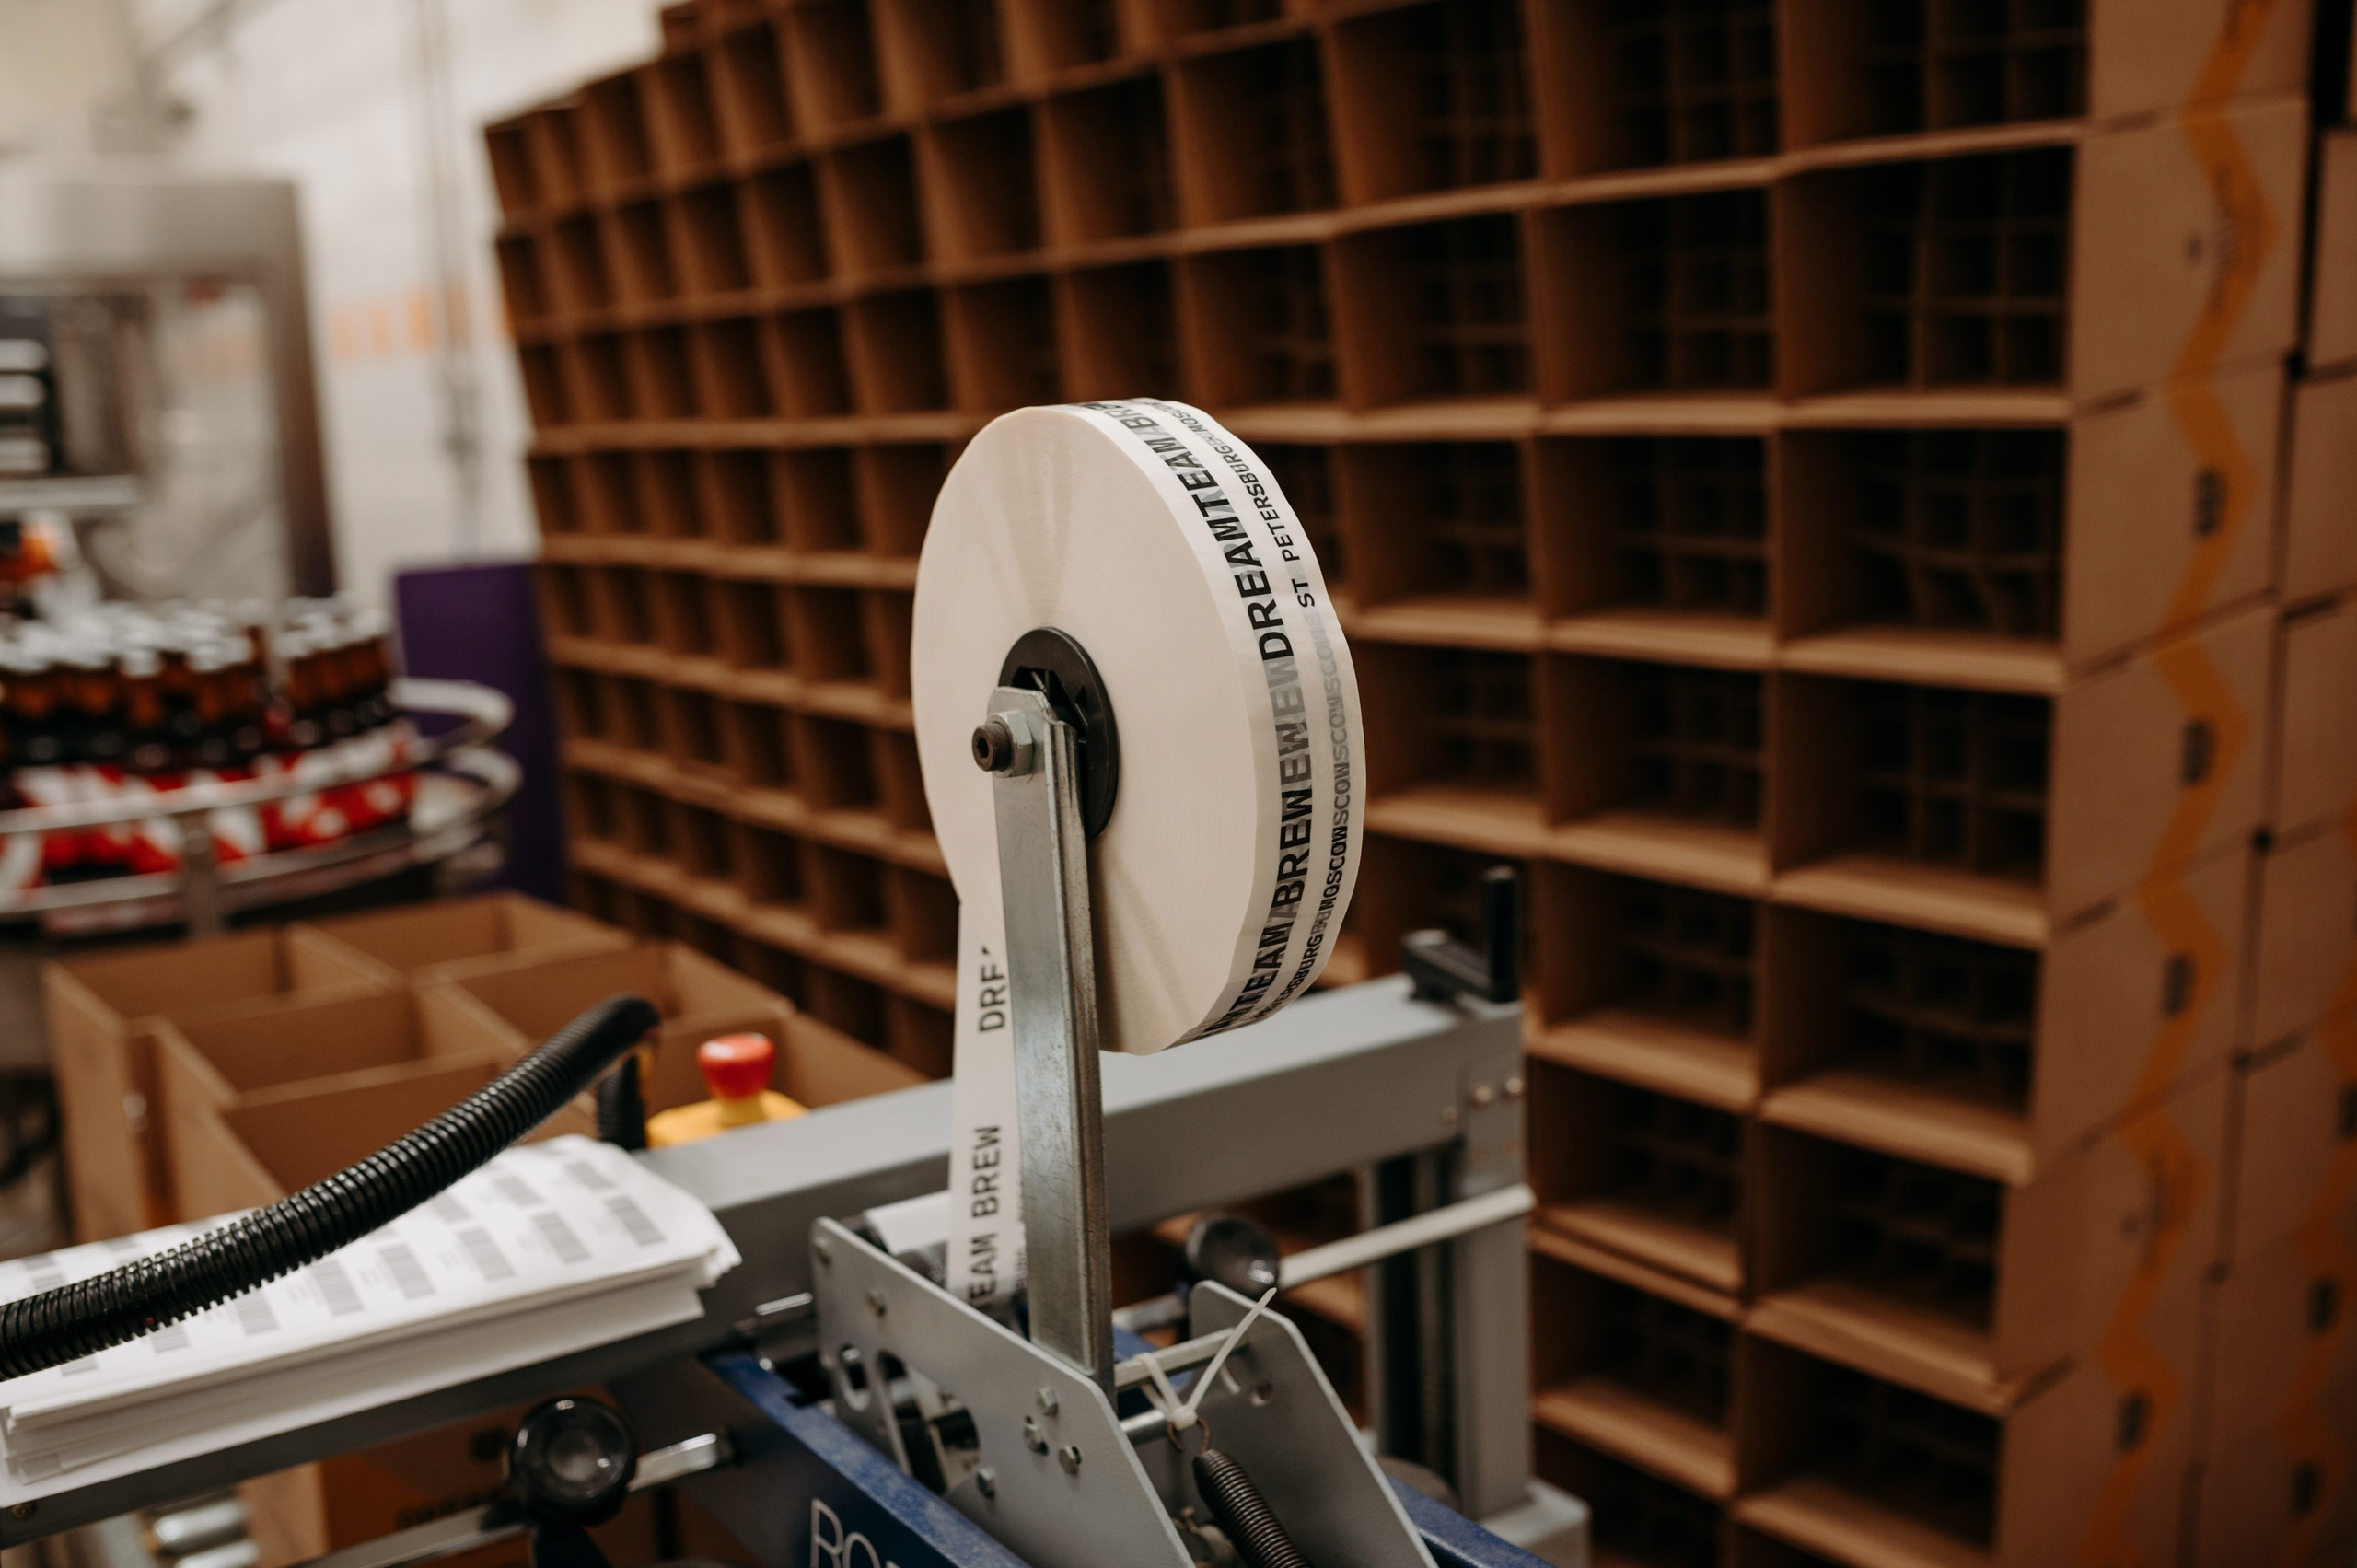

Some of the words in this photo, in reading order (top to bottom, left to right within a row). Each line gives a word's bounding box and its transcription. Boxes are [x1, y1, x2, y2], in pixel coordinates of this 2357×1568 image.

[1144, 436, 1231, 517] TEAM
[1214, 445, 1300, 562] PETERSBURG
[1206, 516, 1295, 660] DREAM
[1291, 578, 1315, 608] ST
[1229, 922, 1295, 1011] TEAM
[1271, 789, 1313, 908] BREW
[1318, 826, 1348, 912] MOSCOW
[970, 1126, 1001, 1219] BREW
